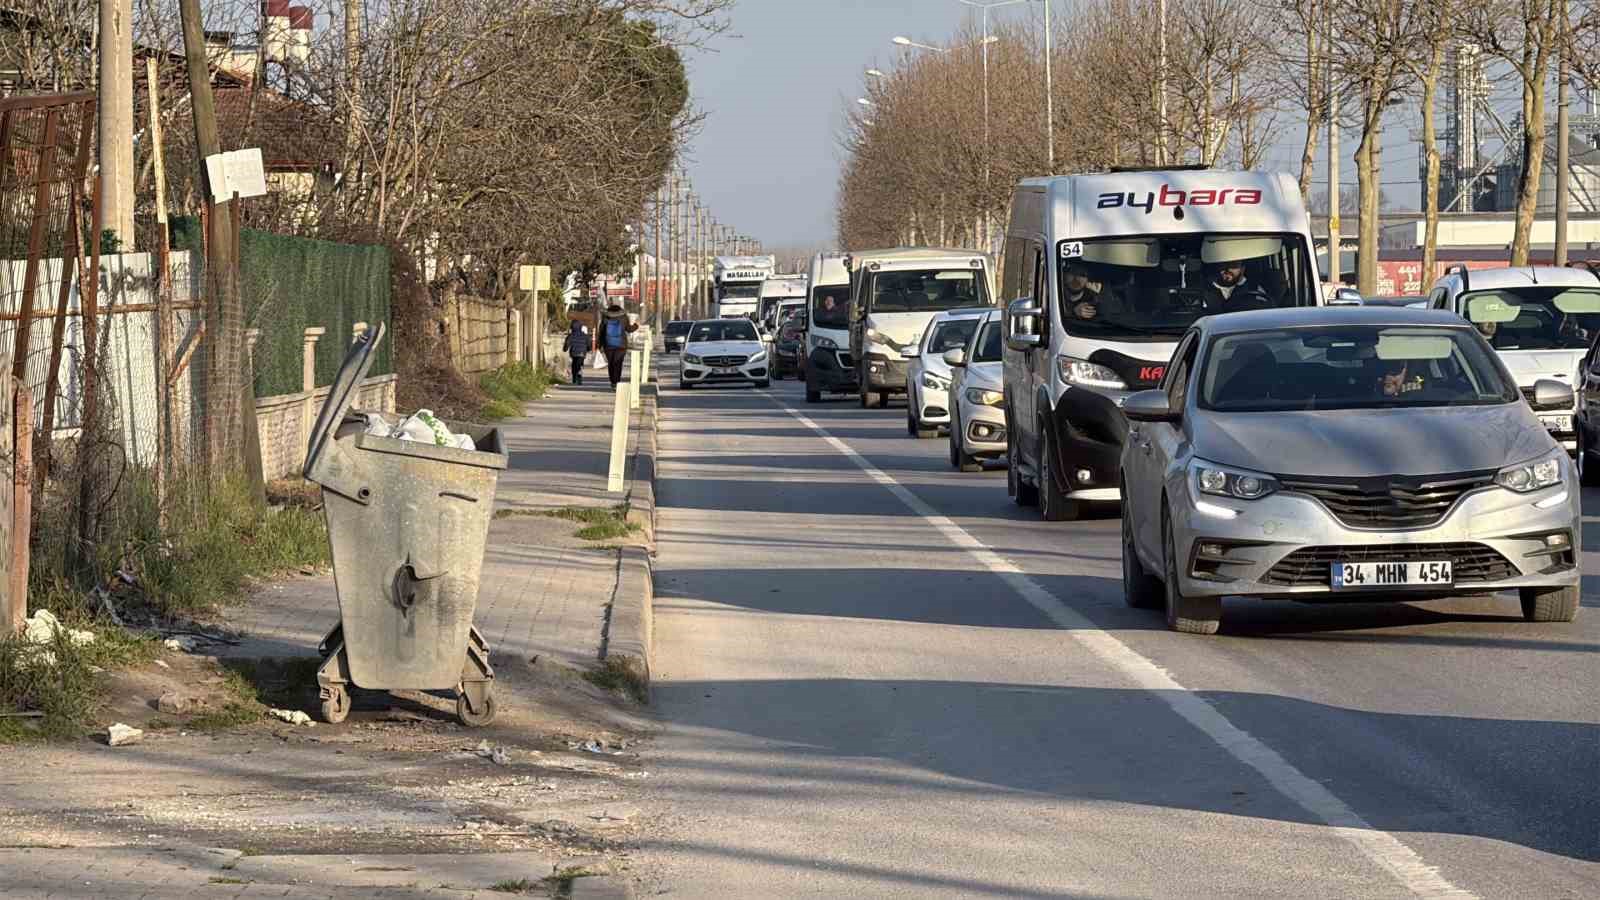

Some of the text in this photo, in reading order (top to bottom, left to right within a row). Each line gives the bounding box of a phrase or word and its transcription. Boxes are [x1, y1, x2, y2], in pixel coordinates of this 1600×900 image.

[1097, 184, 1262, 214] aybara
[1063, 243, 1080, 257] 54
[1344, 564, 1365, 583] 34
[1376, 563, 1407, 583] MHN
[1419, 563, 1450, 582] 454
